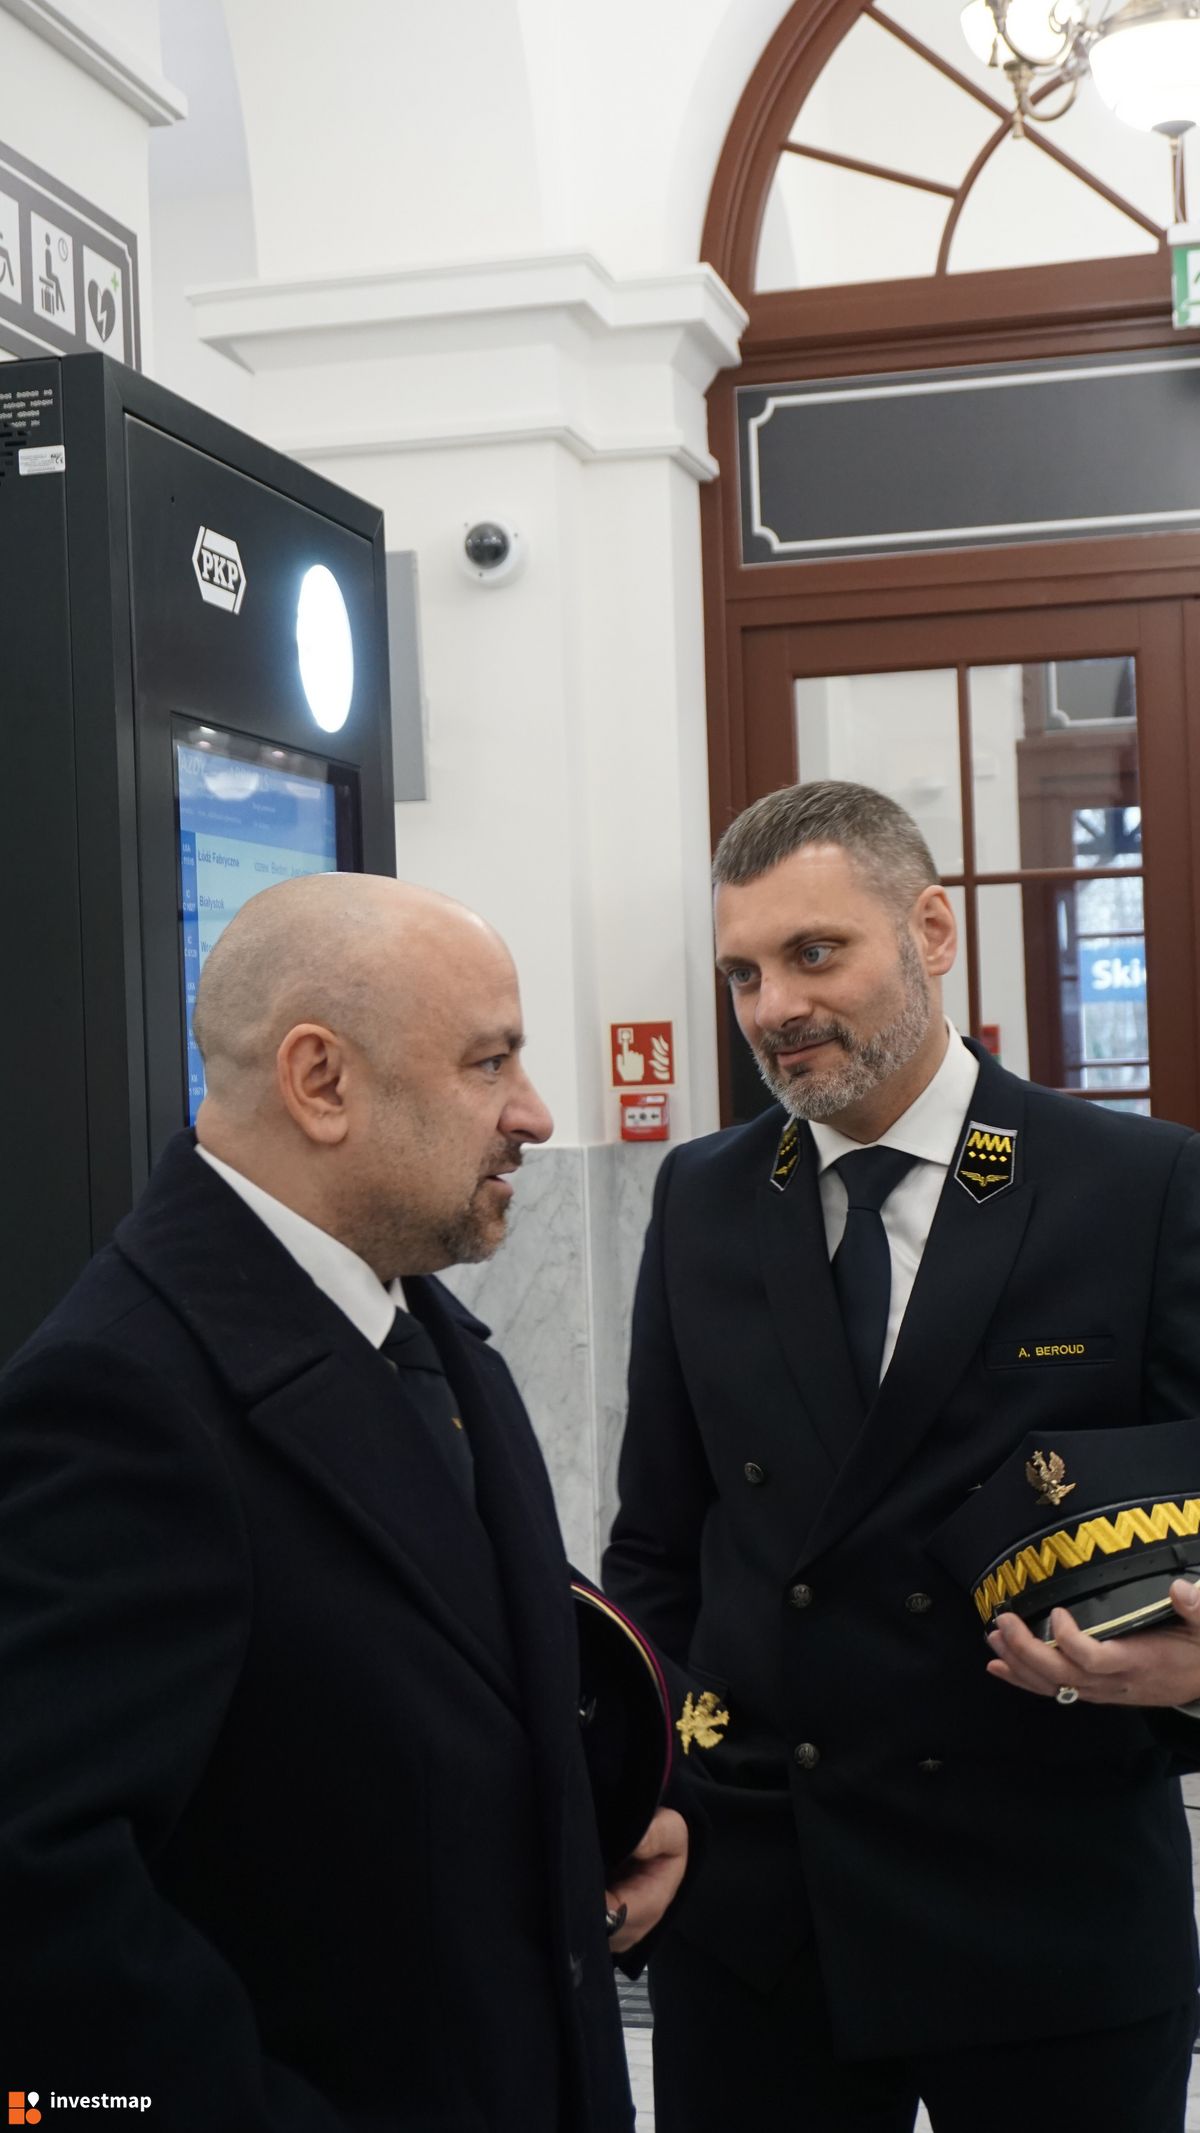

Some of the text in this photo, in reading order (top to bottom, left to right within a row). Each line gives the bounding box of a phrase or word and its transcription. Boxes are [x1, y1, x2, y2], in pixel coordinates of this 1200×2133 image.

[201, 548, 239, 592] PKP
[1092, 957, 1146, 990] Ski
[1018, 1344, 1085, 1358] A. BEROUD
